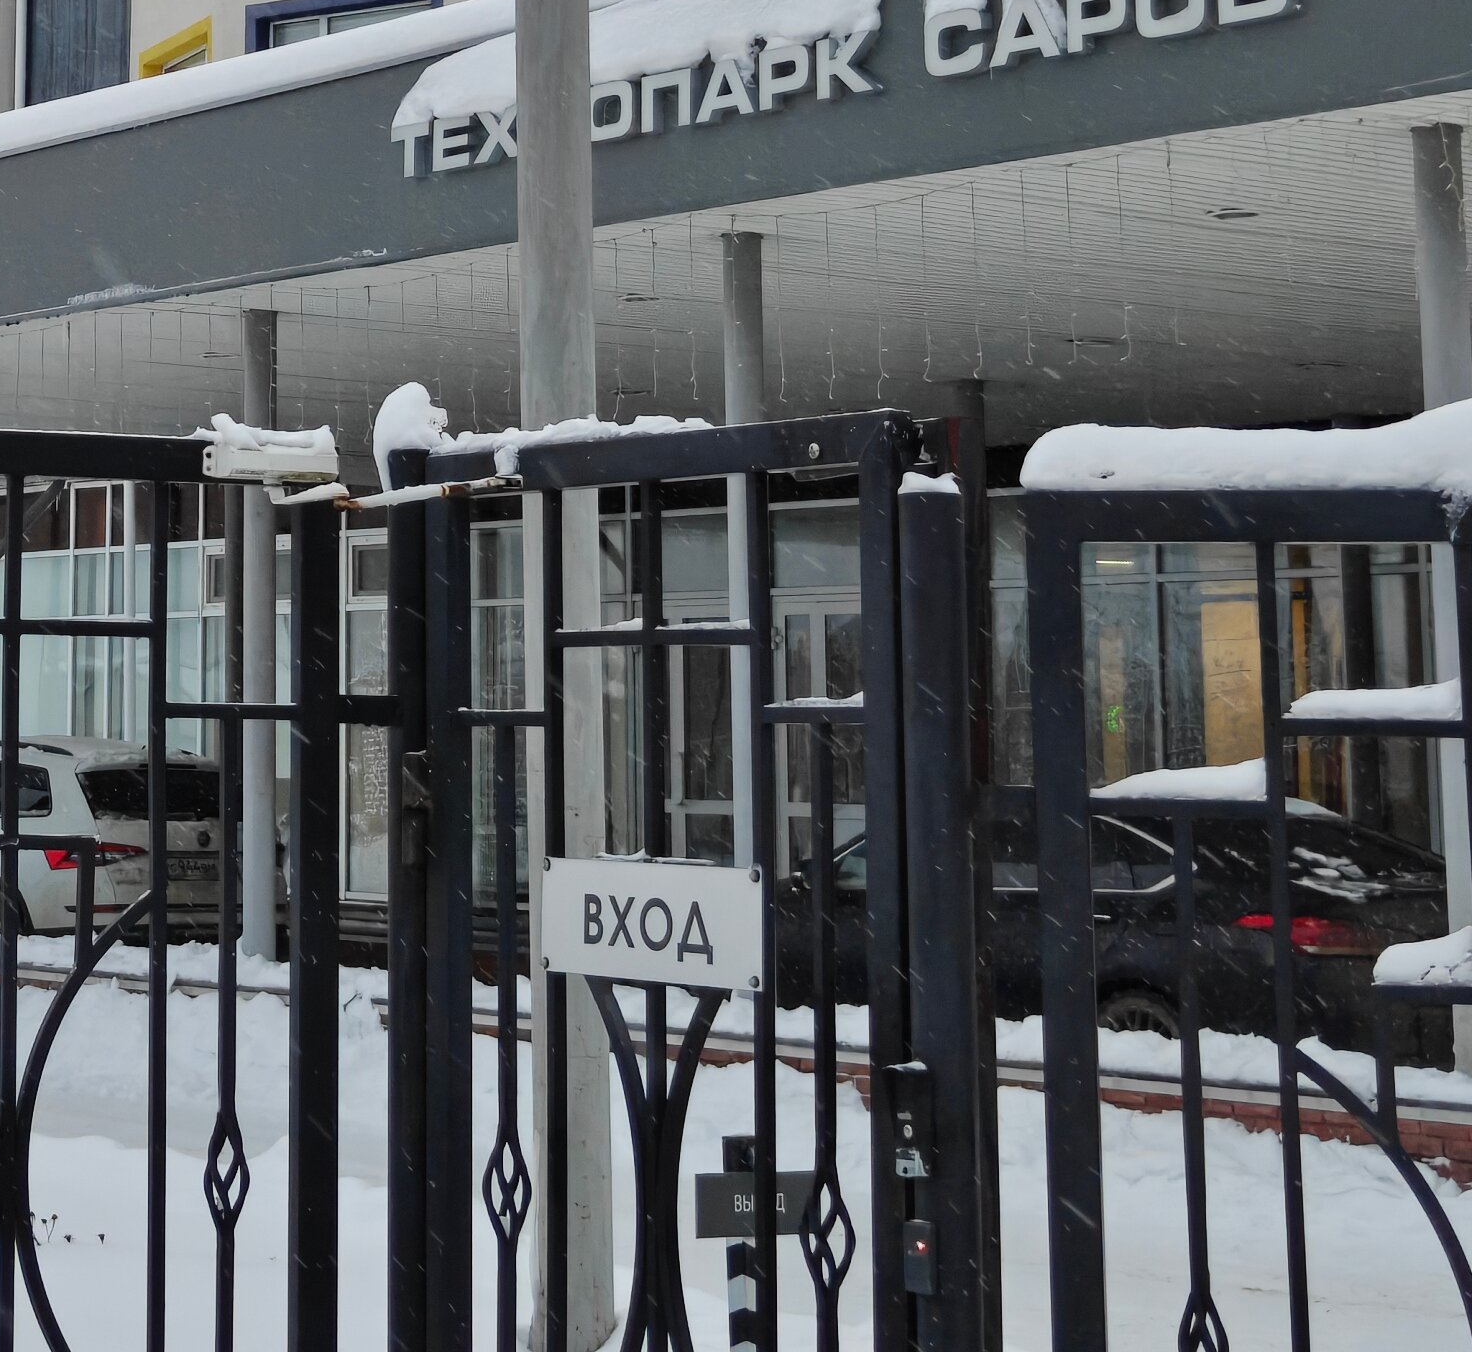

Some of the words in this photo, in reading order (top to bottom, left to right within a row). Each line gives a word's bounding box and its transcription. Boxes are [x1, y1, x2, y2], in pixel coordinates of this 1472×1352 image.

[390, 31, 876, 178] ТЕХОПАРК
[583, 893, 714, 965] ВХОД
[734, 1193, 786, 1213] ВЫД
